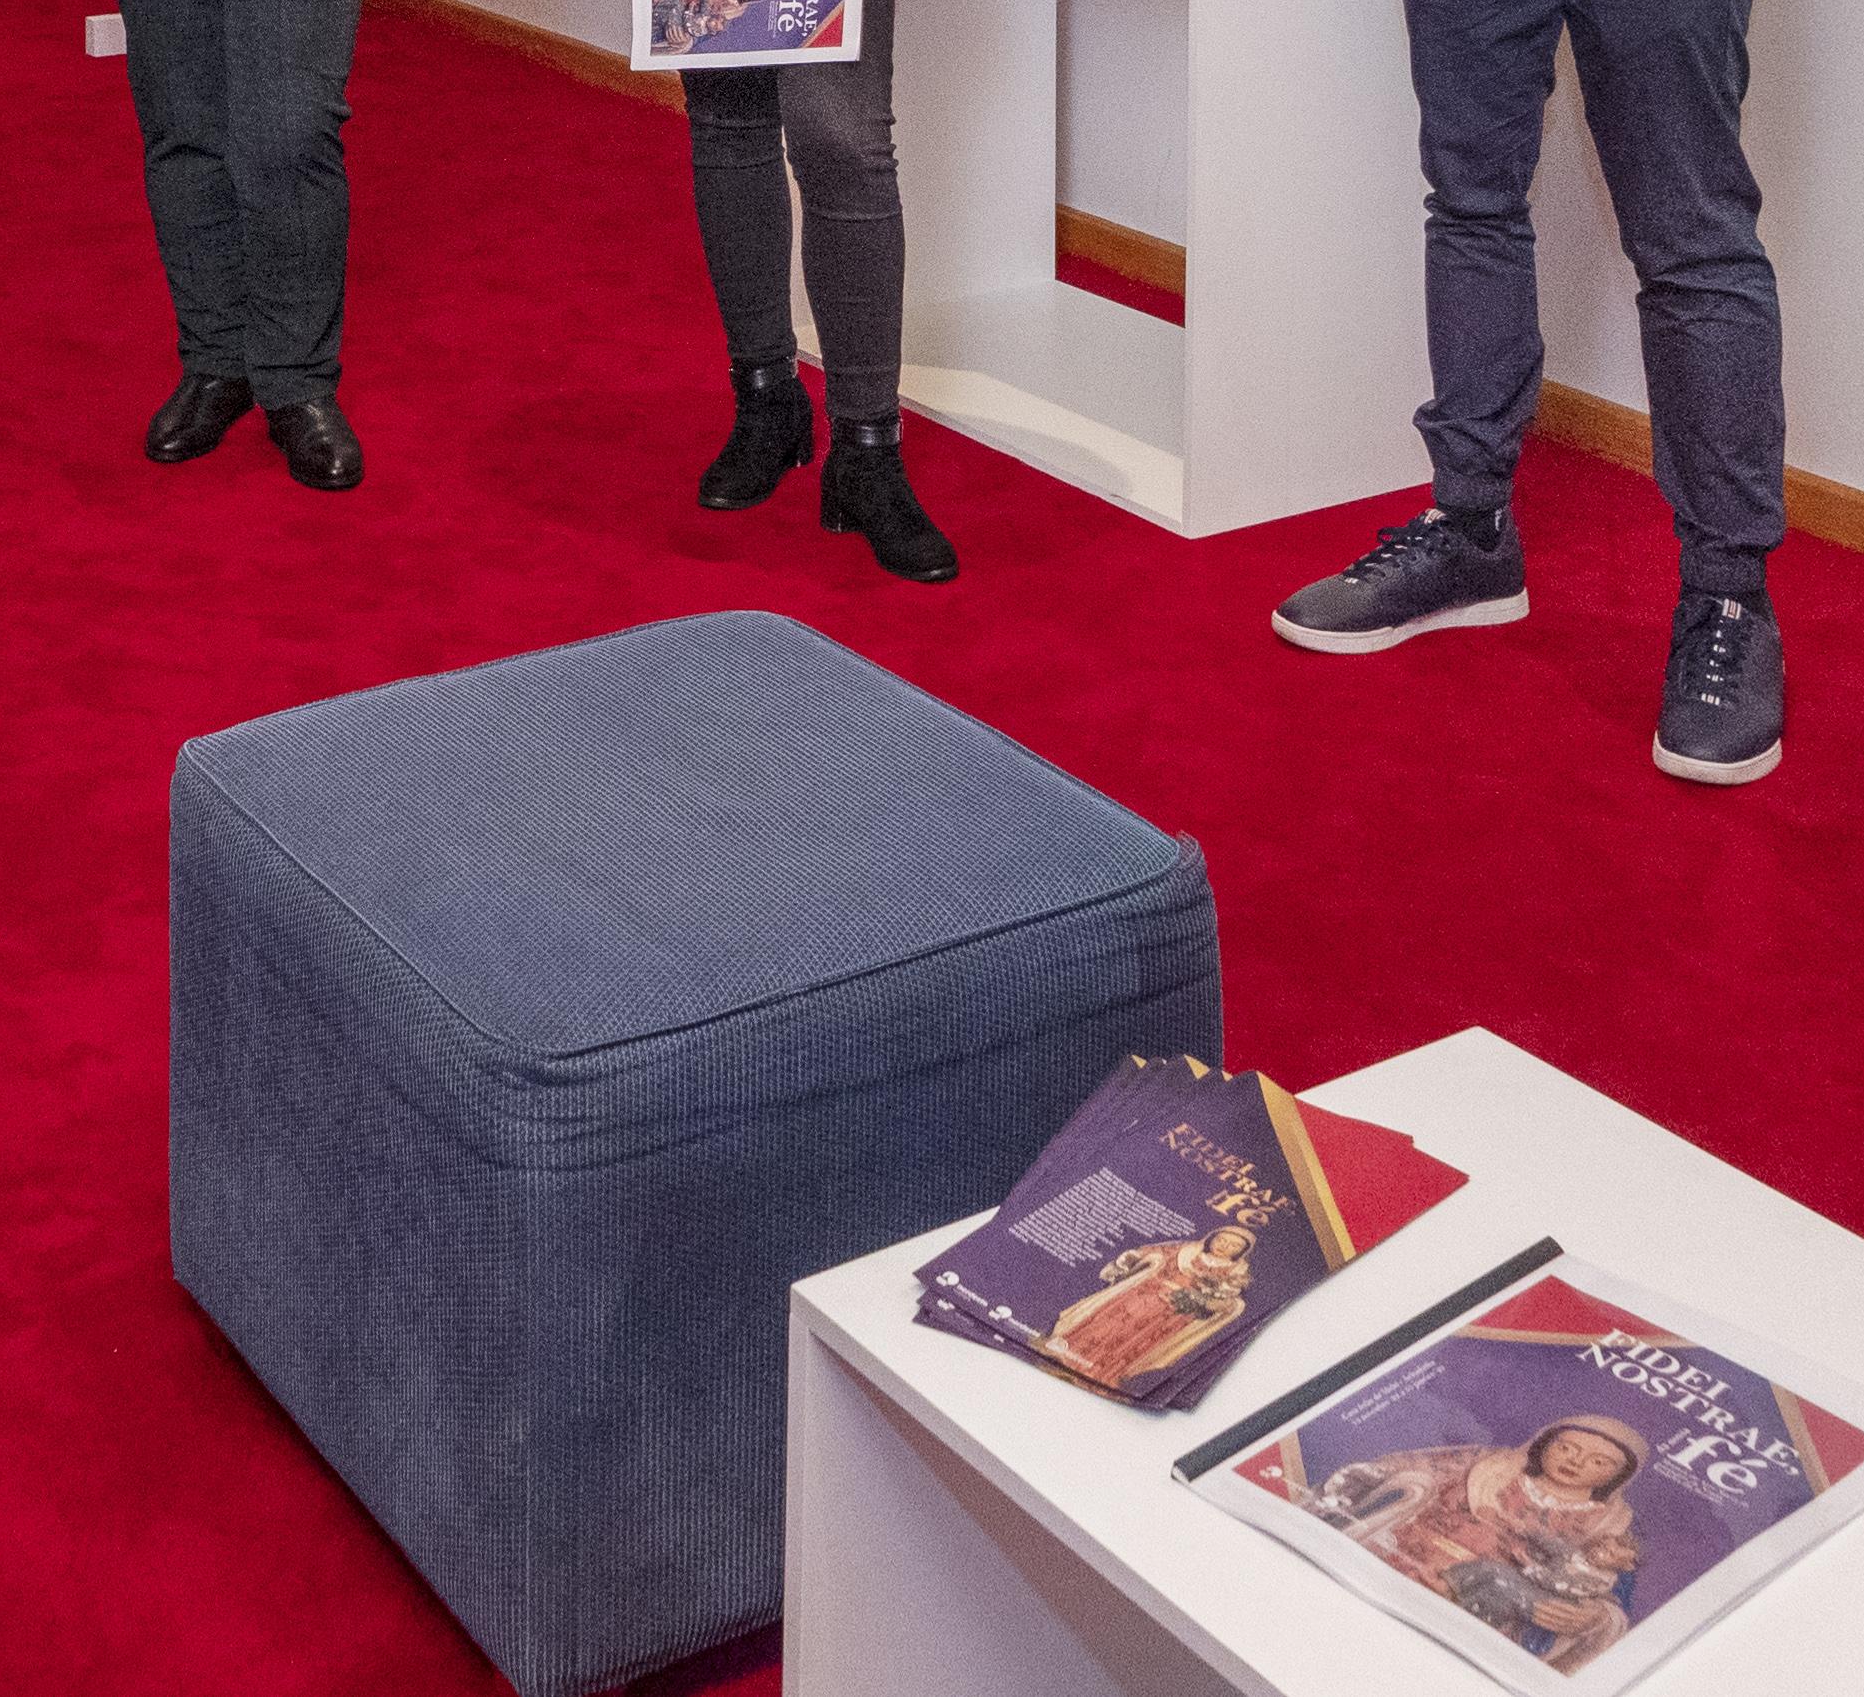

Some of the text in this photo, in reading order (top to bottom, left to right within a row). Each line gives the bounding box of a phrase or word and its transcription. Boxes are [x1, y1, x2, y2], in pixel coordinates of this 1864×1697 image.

[1211, 1193, 1277, 1228] fé
[1599, 1327, 1732, 1401] FIDEI
[1575, 1341, 1800, 1476] NOSTRAE,
[1667, 1434, 1768, 1495] fé
